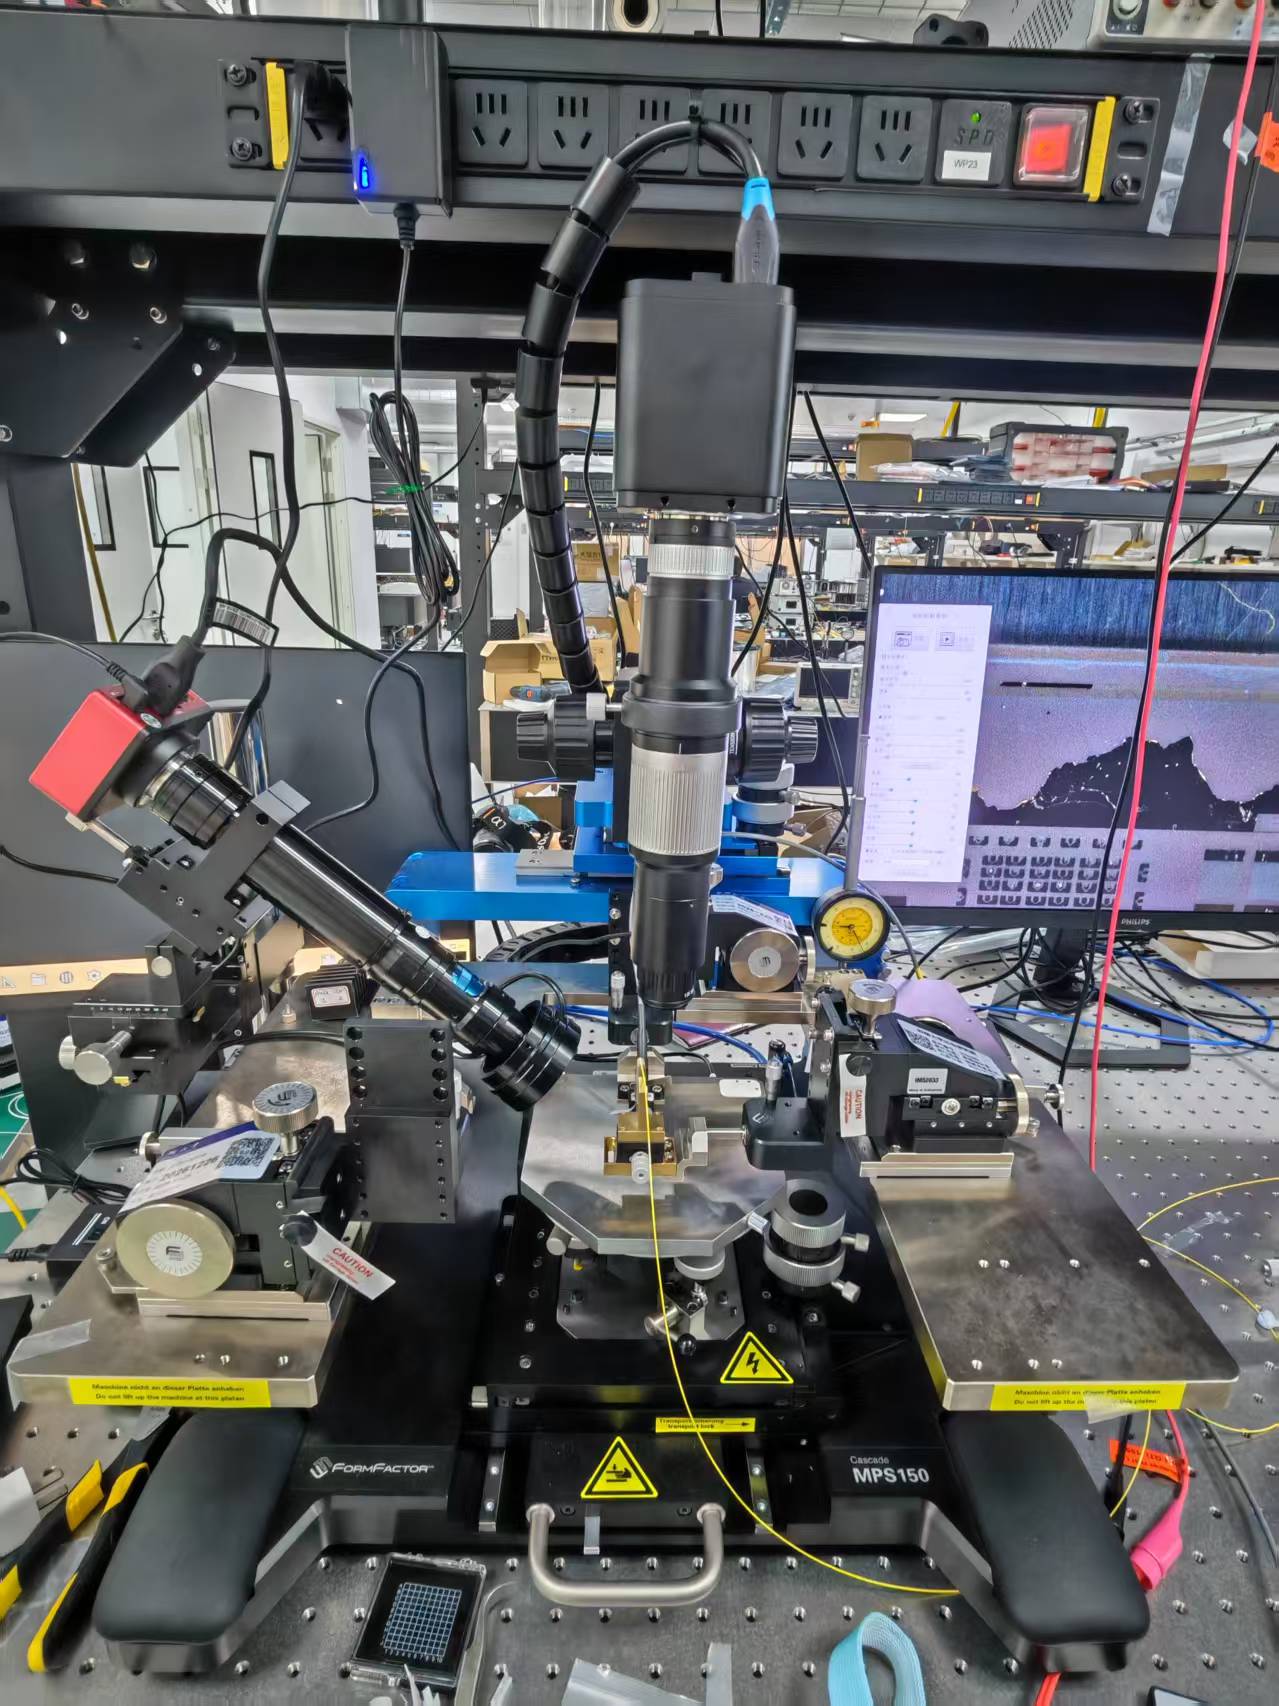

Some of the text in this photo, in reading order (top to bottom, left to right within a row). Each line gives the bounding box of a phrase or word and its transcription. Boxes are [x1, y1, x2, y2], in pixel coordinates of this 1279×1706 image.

[953, 159, 978, 169] WP23
[855, 1089, 863, 1120] CAUTION
[332, 1247, 374, 1278] CAUTION
[849, 1455, 890, 1464] Cascade
[852, 1467, 930, 1483] MPS150
